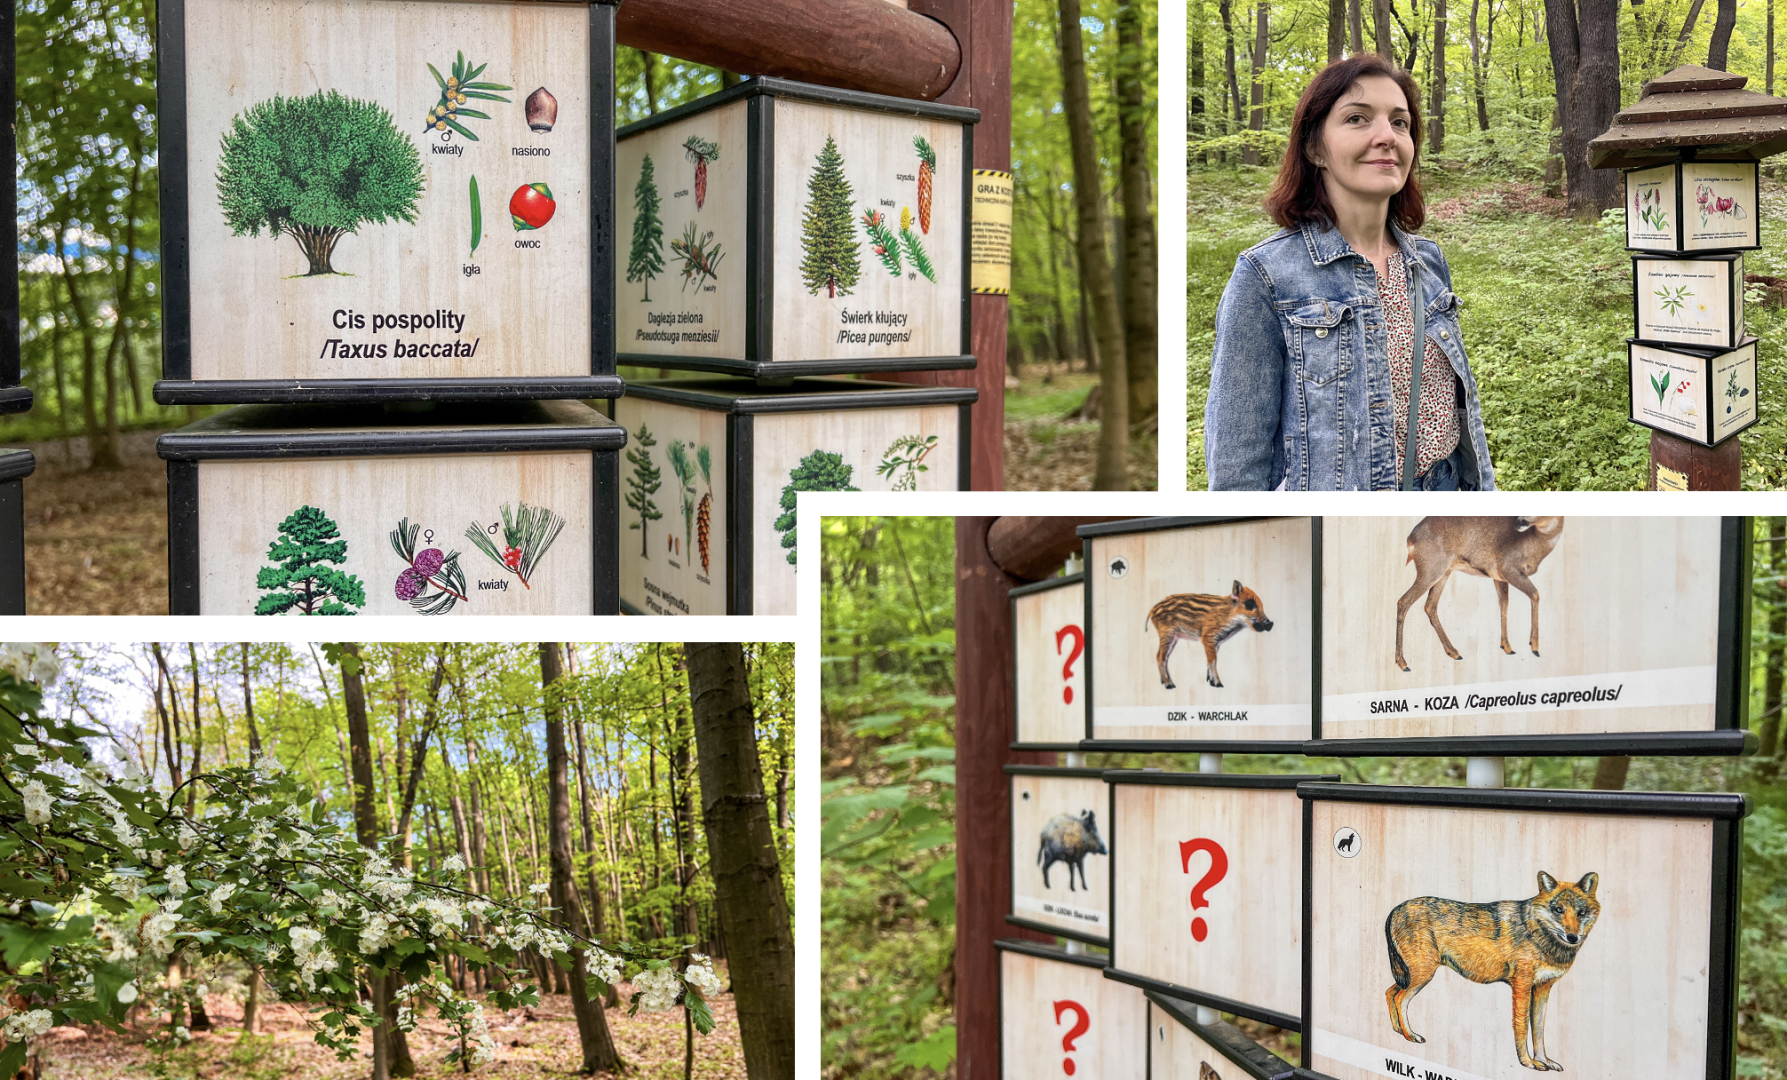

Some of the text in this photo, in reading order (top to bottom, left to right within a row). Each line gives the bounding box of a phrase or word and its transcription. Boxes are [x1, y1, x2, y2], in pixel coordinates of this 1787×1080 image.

[431, 143, 464, 157] kwiaty
[511, 145, 551, 156] nasiono
[977, 184, 994, 195] GRA
[880, 198, 896, 208] kwiaty
[514, 240, 541, 249] owoc
[462, 263, 481, 277] igła
[332, 309, 466, 334] Cis pospolity
[648, 311, 703, 326] Daglezja zielona
[841, 307, 908, 327] Świerk kłujący
[635, 328, 720, 345] /Pseudotsuga menziesii/
[836, 329, 912, 346] /Picea pungens/
[319, 337, 480, 359] /Taxus baccata/
[478, 578, 509, 591] kwiaty
[1055, 624, 1085, 705] ?
[1370, 699, 1409, 713] SARNA
[1424, 696, 1459, 711] KOZA
[1464, 692, 1537, 711] /Capreolus
[1540, 684, 1623, 707] capreolus/
[1167, 711, 1187, 721] DZIK
[1198, 711, 1248, 721] WARCHLAK
[1178, 837, 1229, 942] ?
[1053, 1000, 1091, 1076] ?
[1385, 1058, 1415, 1079] WILK
